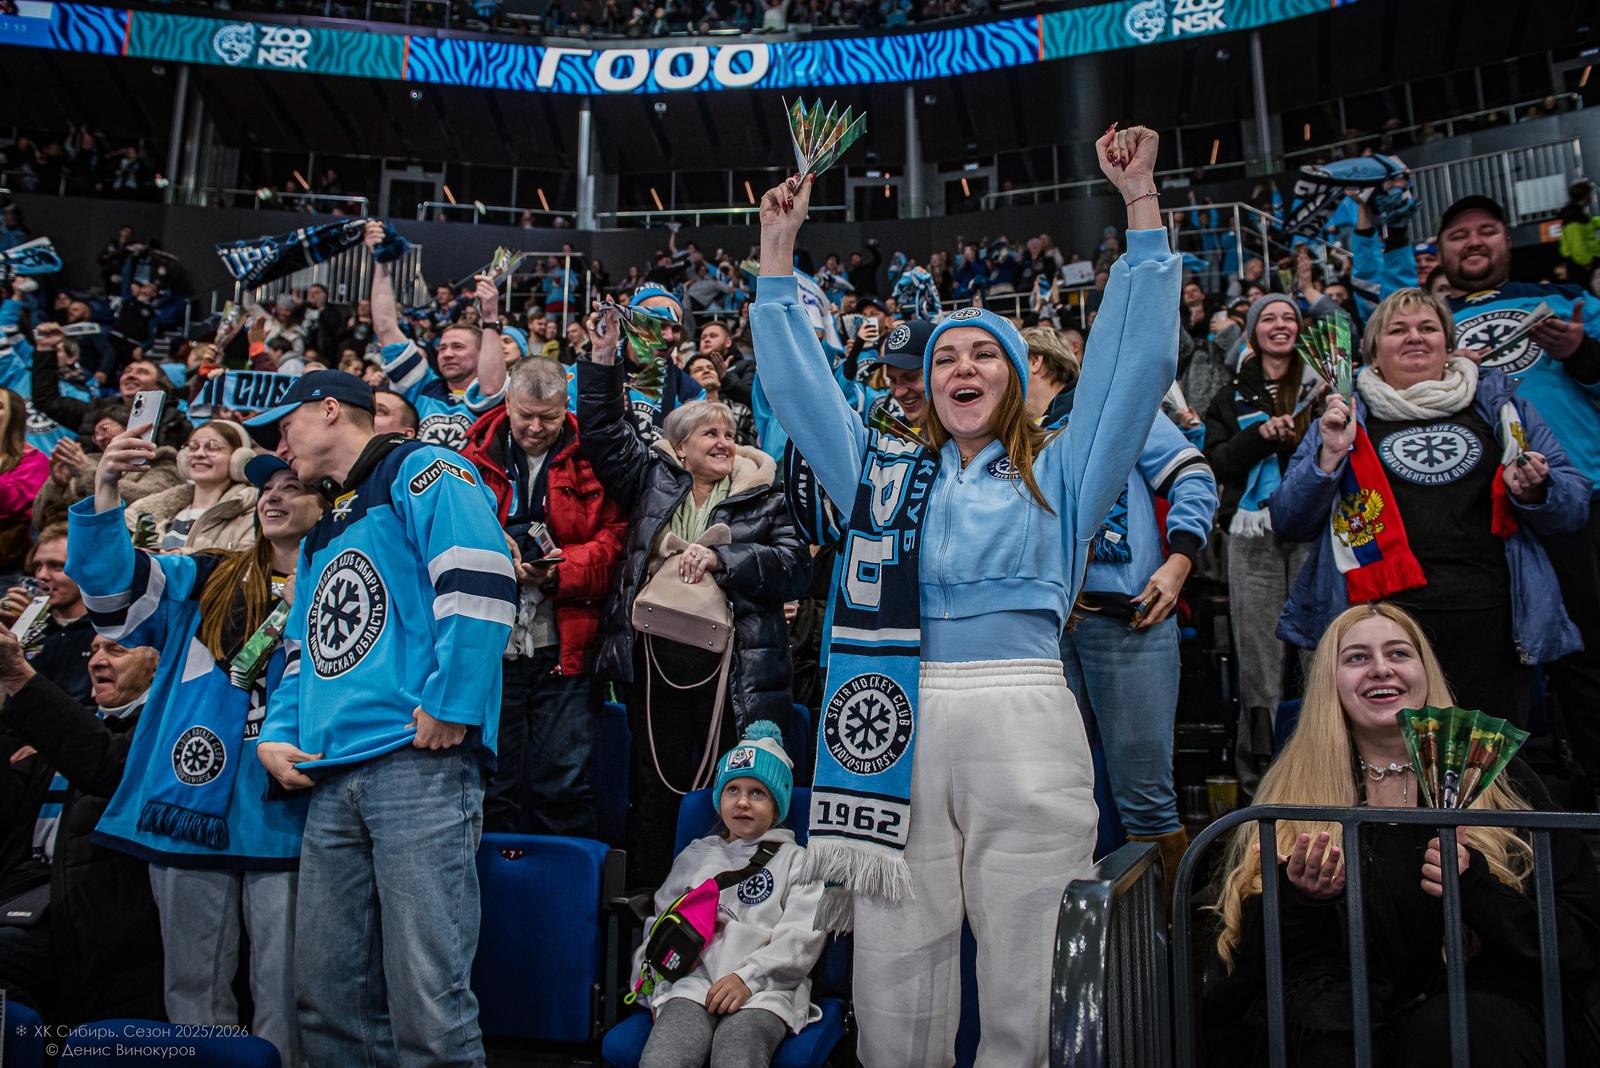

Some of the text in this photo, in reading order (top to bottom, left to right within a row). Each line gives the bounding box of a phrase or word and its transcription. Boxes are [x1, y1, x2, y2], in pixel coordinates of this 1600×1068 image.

[260, 26, 312, 48] ZOO
[1172, 8, 1226, 36] NSK
[257, 47, 308, 69] NSK
[339, 553, 355, 568] КЛУБ
[354, 556, 380, 594] СИБИРЬ
[355, 602, 383, 655] ОБЛАСТЬ
[827, 675, 911, 727] SIBIR HOCKEY CLUB
[831, 742, 897, 774] NOVOSIBIRSK
[817, 800, 901, 838] 1962
